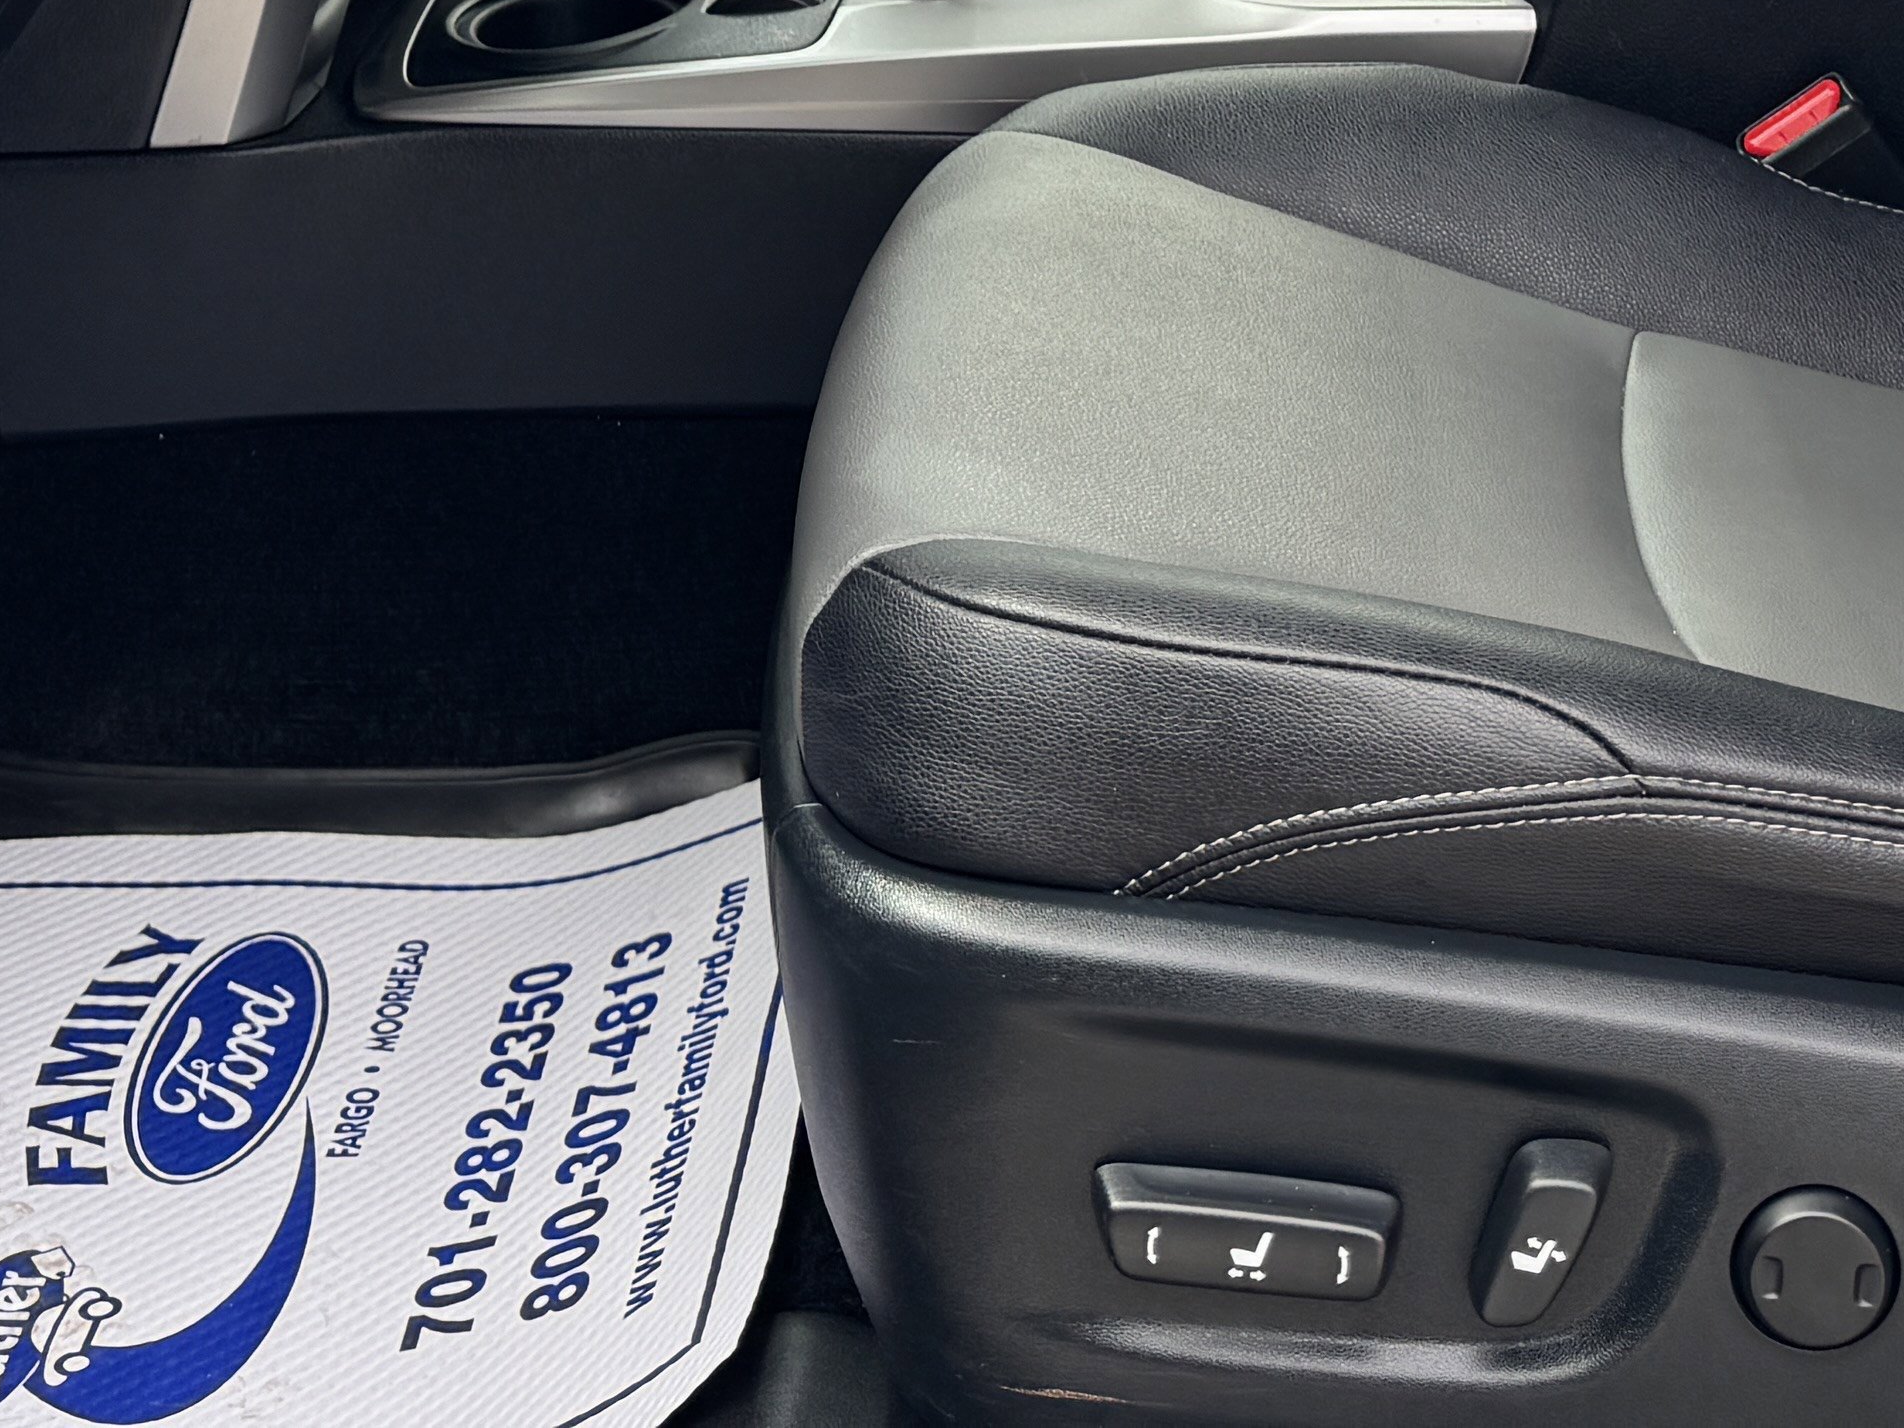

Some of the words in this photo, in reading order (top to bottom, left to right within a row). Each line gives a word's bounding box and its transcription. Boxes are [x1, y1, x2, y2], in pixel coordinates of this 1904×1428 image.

[25, 922, 206, 1187] FAMILY
[152, 979, 295, 1131] Ford
[325, 1087, 381, 1159] FARGO
[370, 939, 430, 1053] MOORHEAD
[399, 961, 574, 1352] 701-282-2350
[519, 931, 674, 1322] 800-307-4813
[623, 876, 751, 1320] www.lutherfamilyford.com
